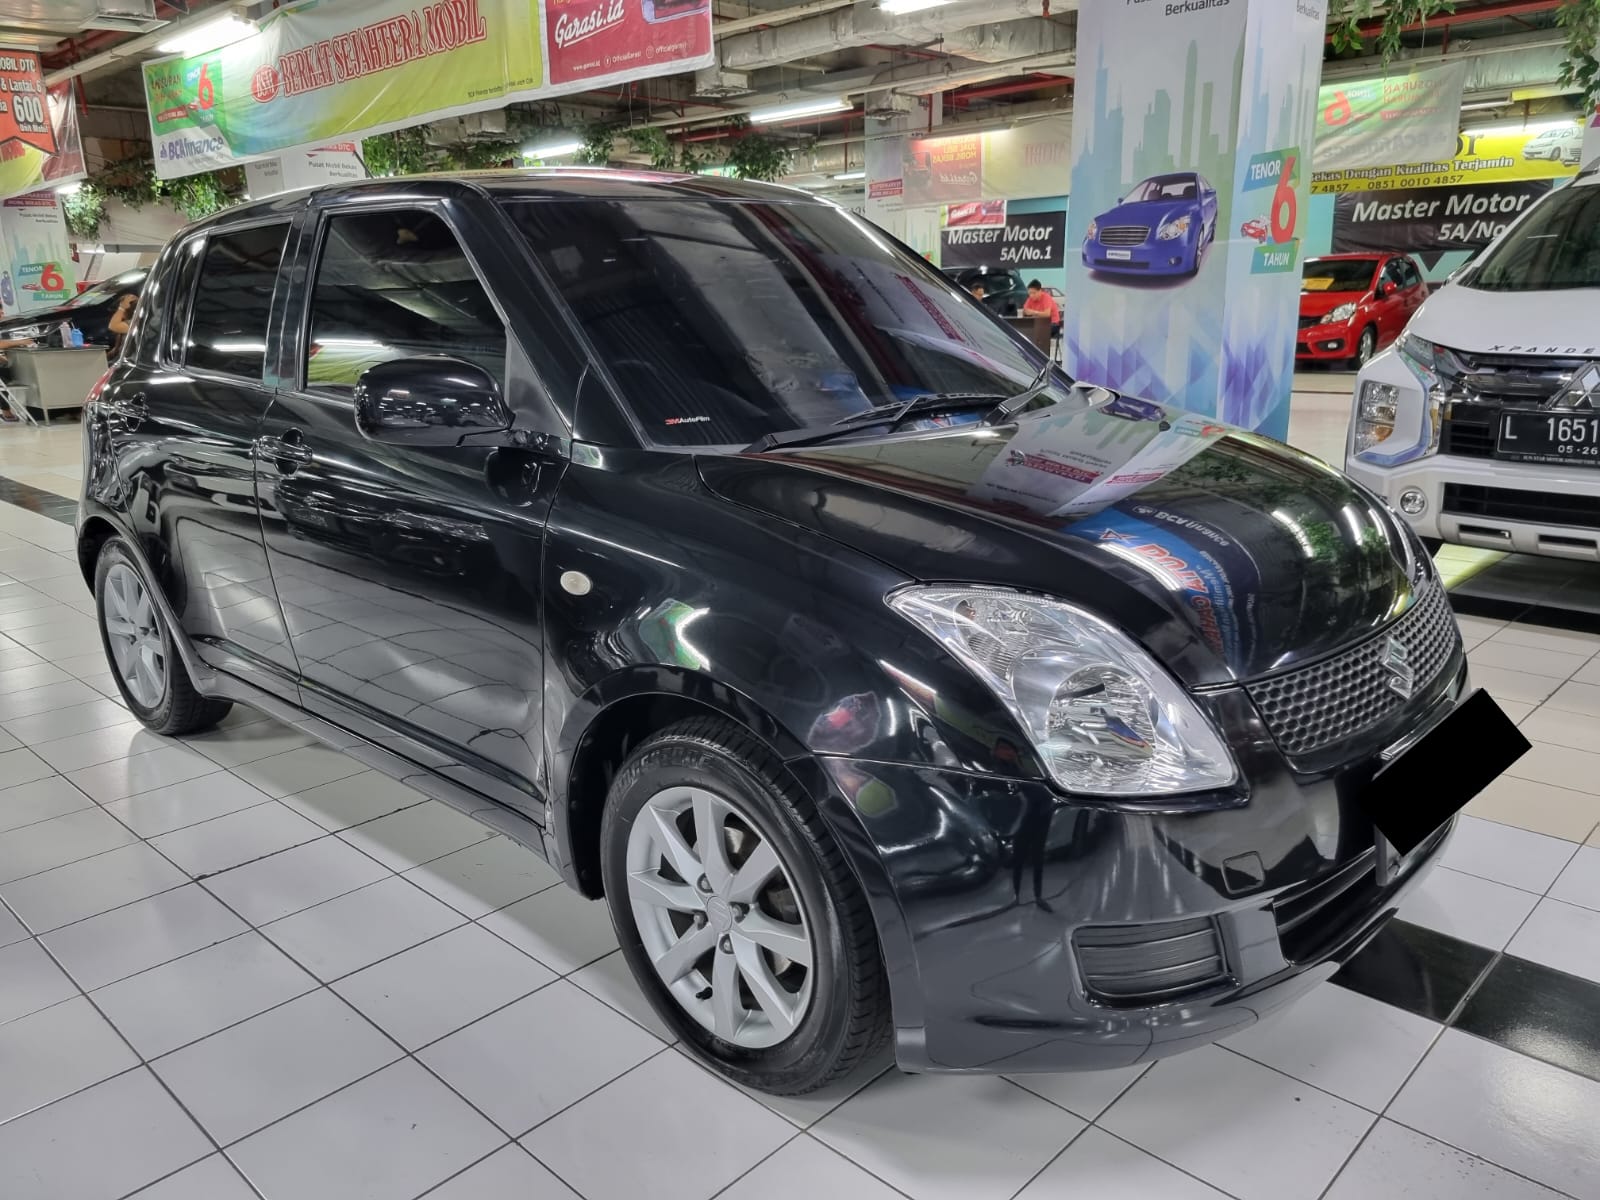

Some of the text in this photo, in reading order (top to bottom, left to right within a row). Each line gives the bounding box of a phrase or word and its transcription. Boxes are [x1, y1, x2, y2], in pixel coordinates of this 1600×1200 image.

[555, 0, 624, 49] Garasi.id
[279, 0, 487, 97] BERKAT SEJAHTERA MOBIL
[0, 57, 17, 71] OBIL
[198, 63, 214, 110] 6
[13, 95, 43, 123] 600
[1345, 167, 1391, 180] Dengan
[1395, 162, 1448, 176] Kualitas
[1453, 156, 1513, 171] Terjamin
[1322, 184, 1348, 193] 4857
[1368, 179, 1394, 189] 0851
[1400, 178, 1430, 188] 0010
[1434, 175, 1463, 184] 4857
[1251, 156, 1296, 244] TENOR 6
[1352, 193, 1530, 223] Master Motor
[948, 225, 1053, 244] Master Motor
[1000, 245, 1052, 263] 5A/No.1
[1263, 253, 1290, 266] TAHUN
[41, 263, 64, 292] 6
[1505, 416, 1598, 443] L 1651
